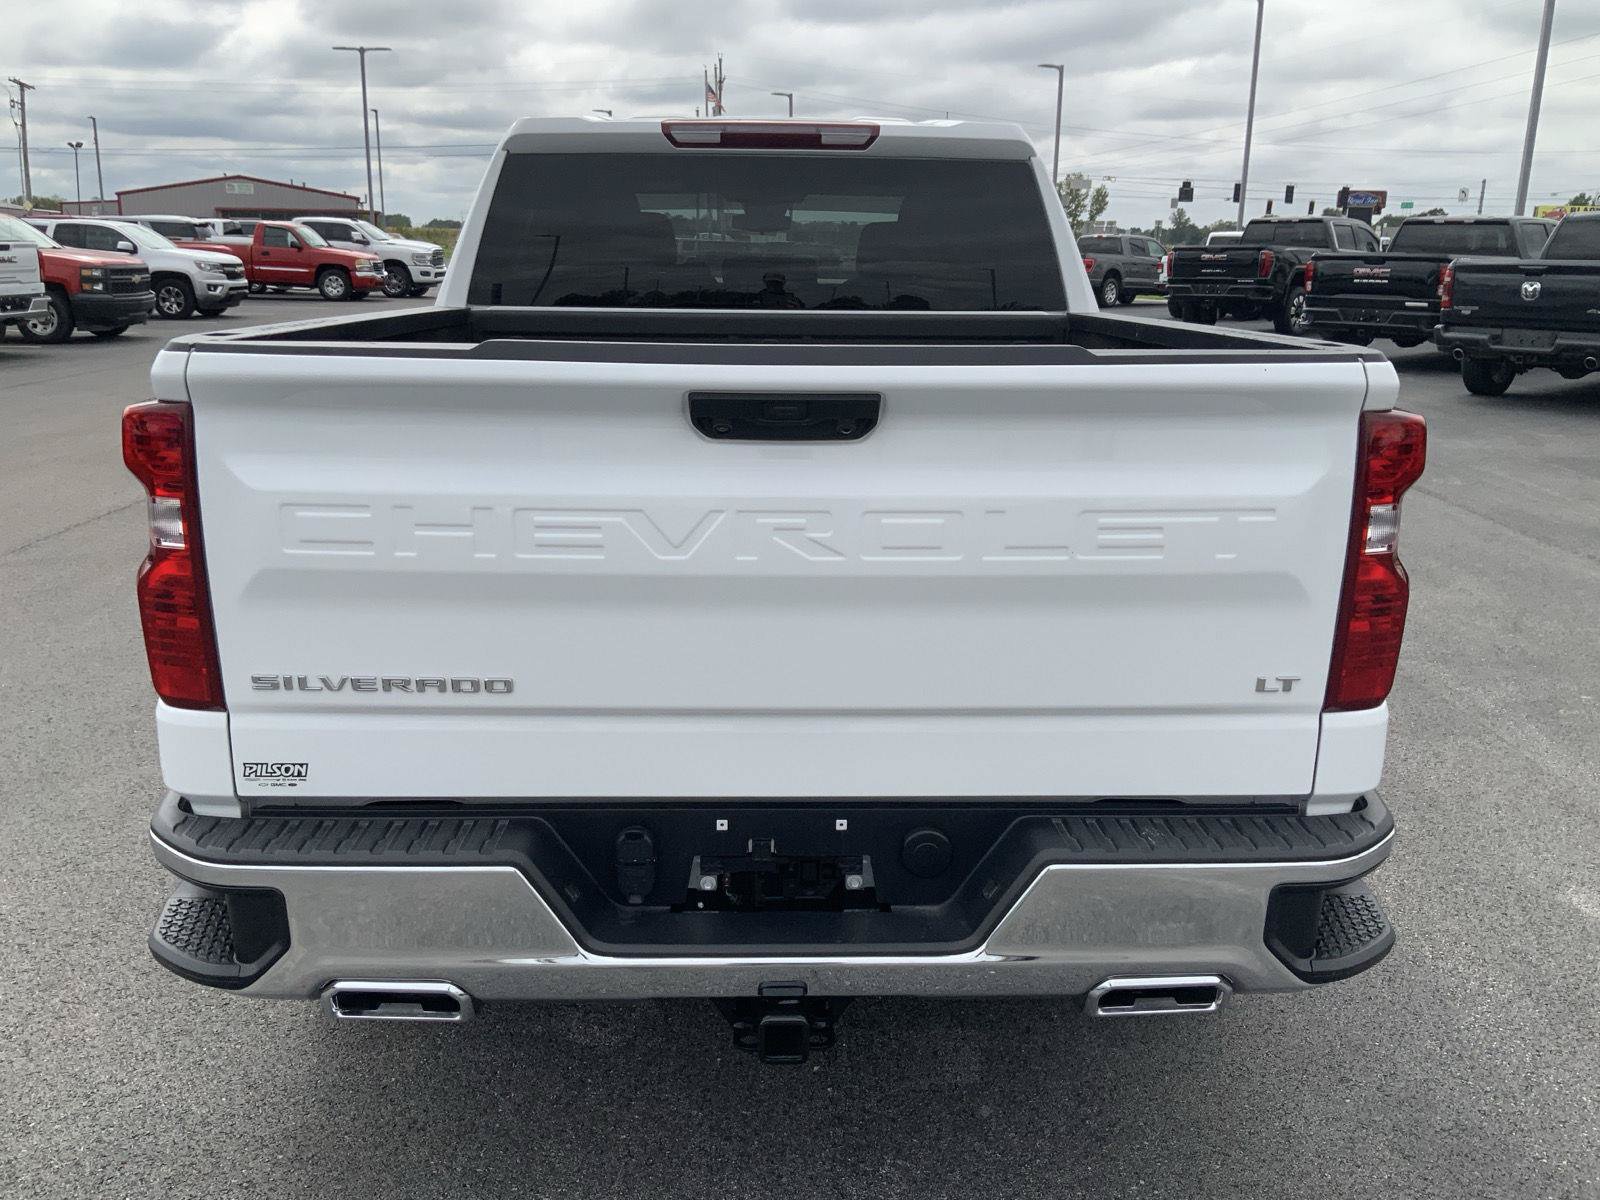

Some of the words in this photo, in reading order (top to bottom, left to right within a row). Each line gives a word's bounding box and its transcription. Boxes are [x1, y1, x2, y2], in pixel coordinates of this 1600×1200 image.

[0, 255, 18, 264] MC
[1353, 267, 1391, 278] GMC
[280, 502, 1278, 563] CHEVROLET
[251, 675, 514, 694] SILVERADO
[1255, 675, 1301, 692] LT
[243, 763, 308, 777] PILSON
